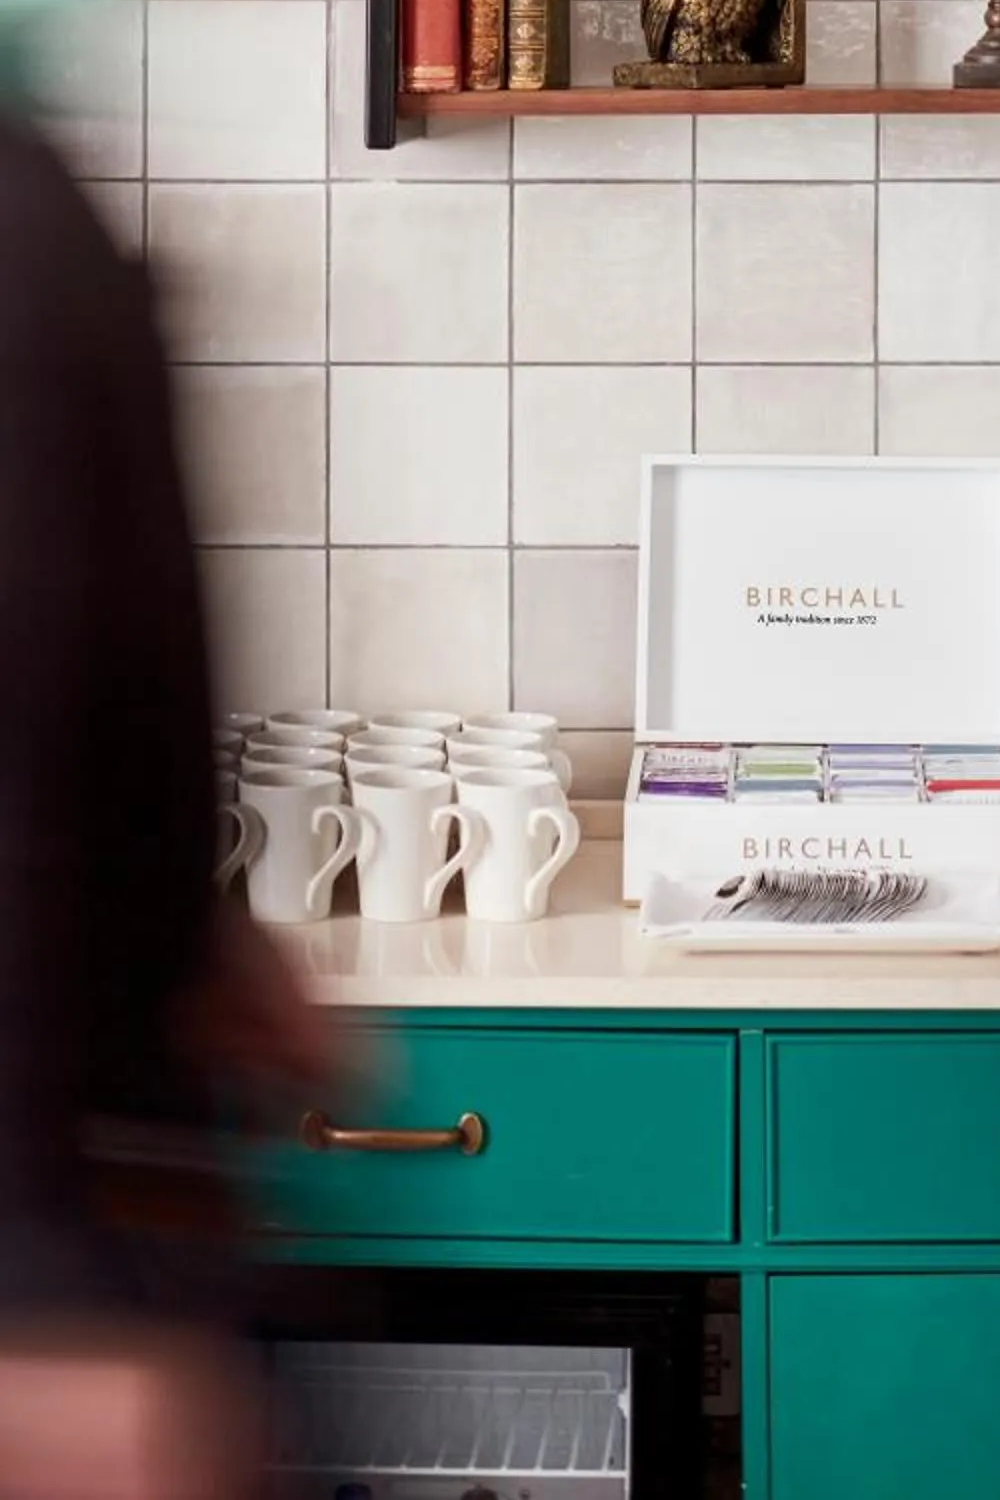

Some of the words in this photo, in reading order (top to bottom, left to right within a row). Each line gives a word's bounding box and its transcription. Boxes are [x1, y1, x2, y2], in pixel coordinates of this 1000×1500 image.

[746, 587, 904, 608] BIRCHALL
[757, 614, 765, 623] A
[766, 613, 793, 626] family
[795, 614, 831, 624] tradition
[833, 616, 855, 624] since
[743, 837, 913, 859] BIRCHALL
